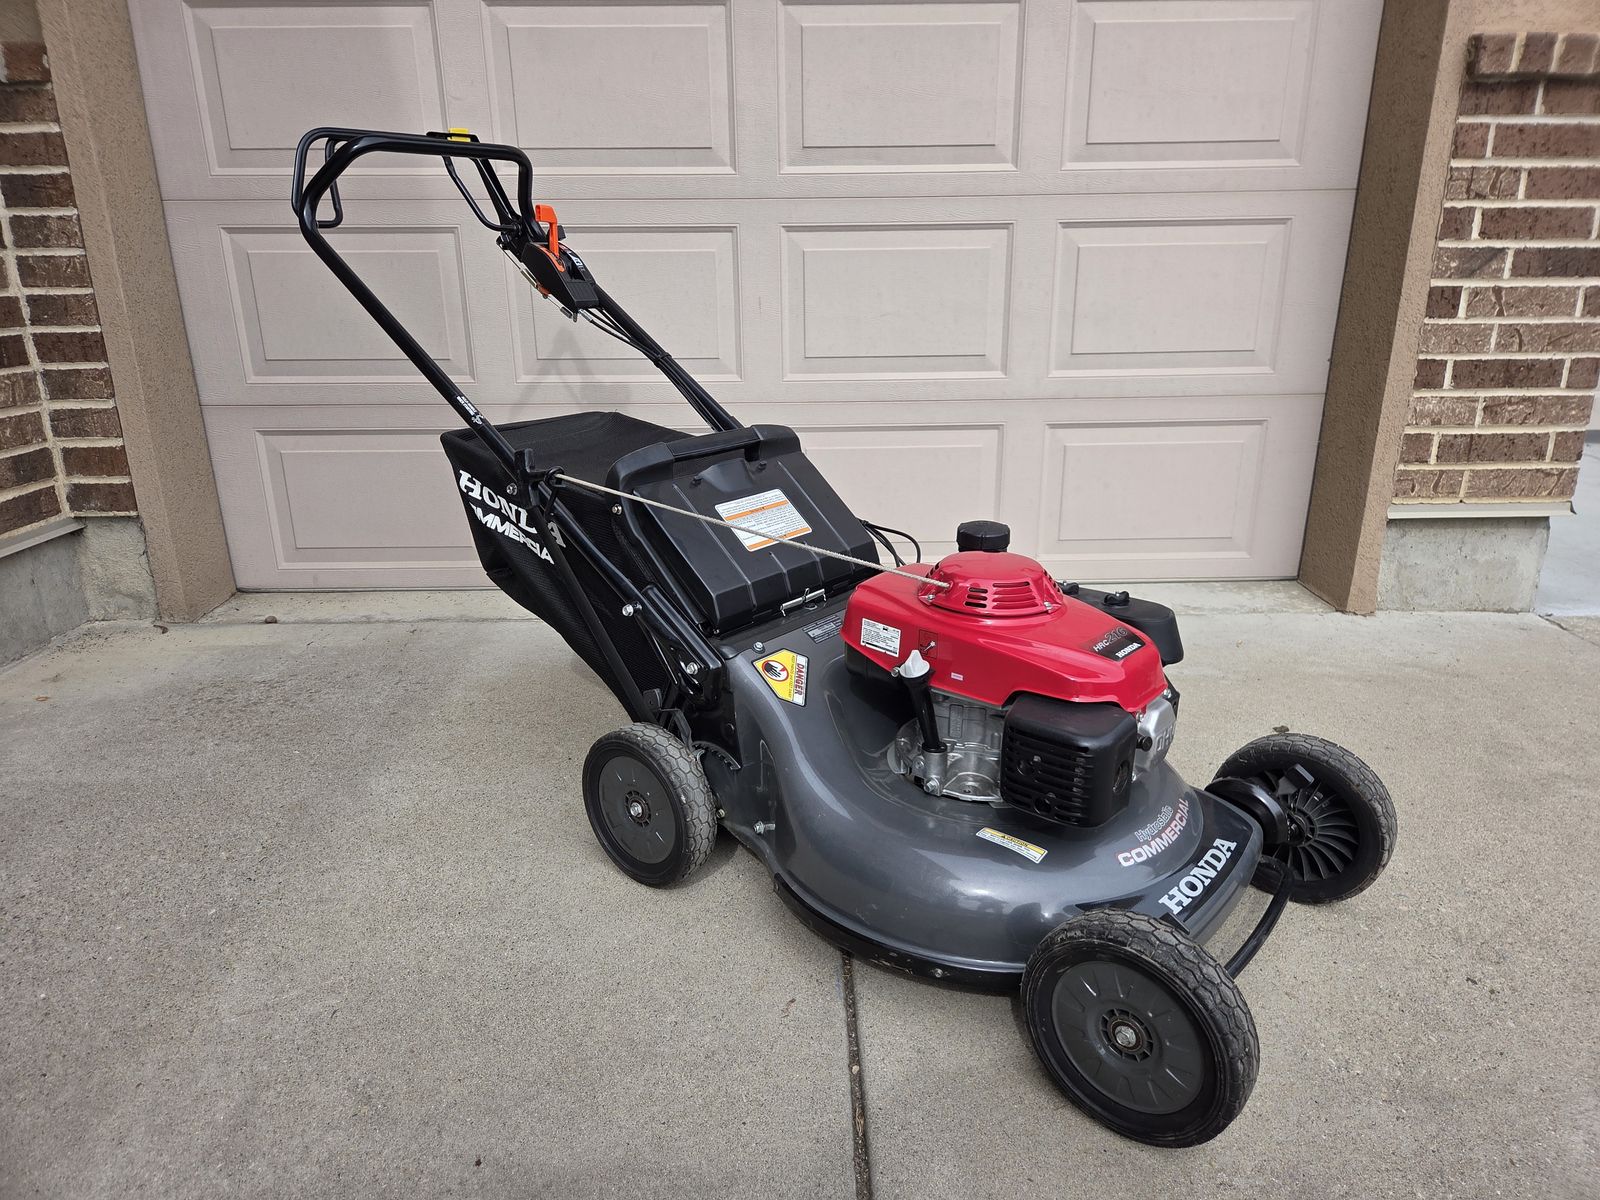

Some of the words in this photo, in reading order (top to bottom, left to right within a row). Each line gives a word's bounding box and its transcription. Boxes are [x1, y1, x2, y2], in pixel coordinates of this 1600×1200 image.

[1115, 642, 1141, 658] HONDA
[795, 663, 804, 695] DANGER
[1117, 798, 1189, 867] COMMERCIAL
[1134, 805, 1174, 842] Hydrostatic
[1158, 837, 1238, 915] HONDA
